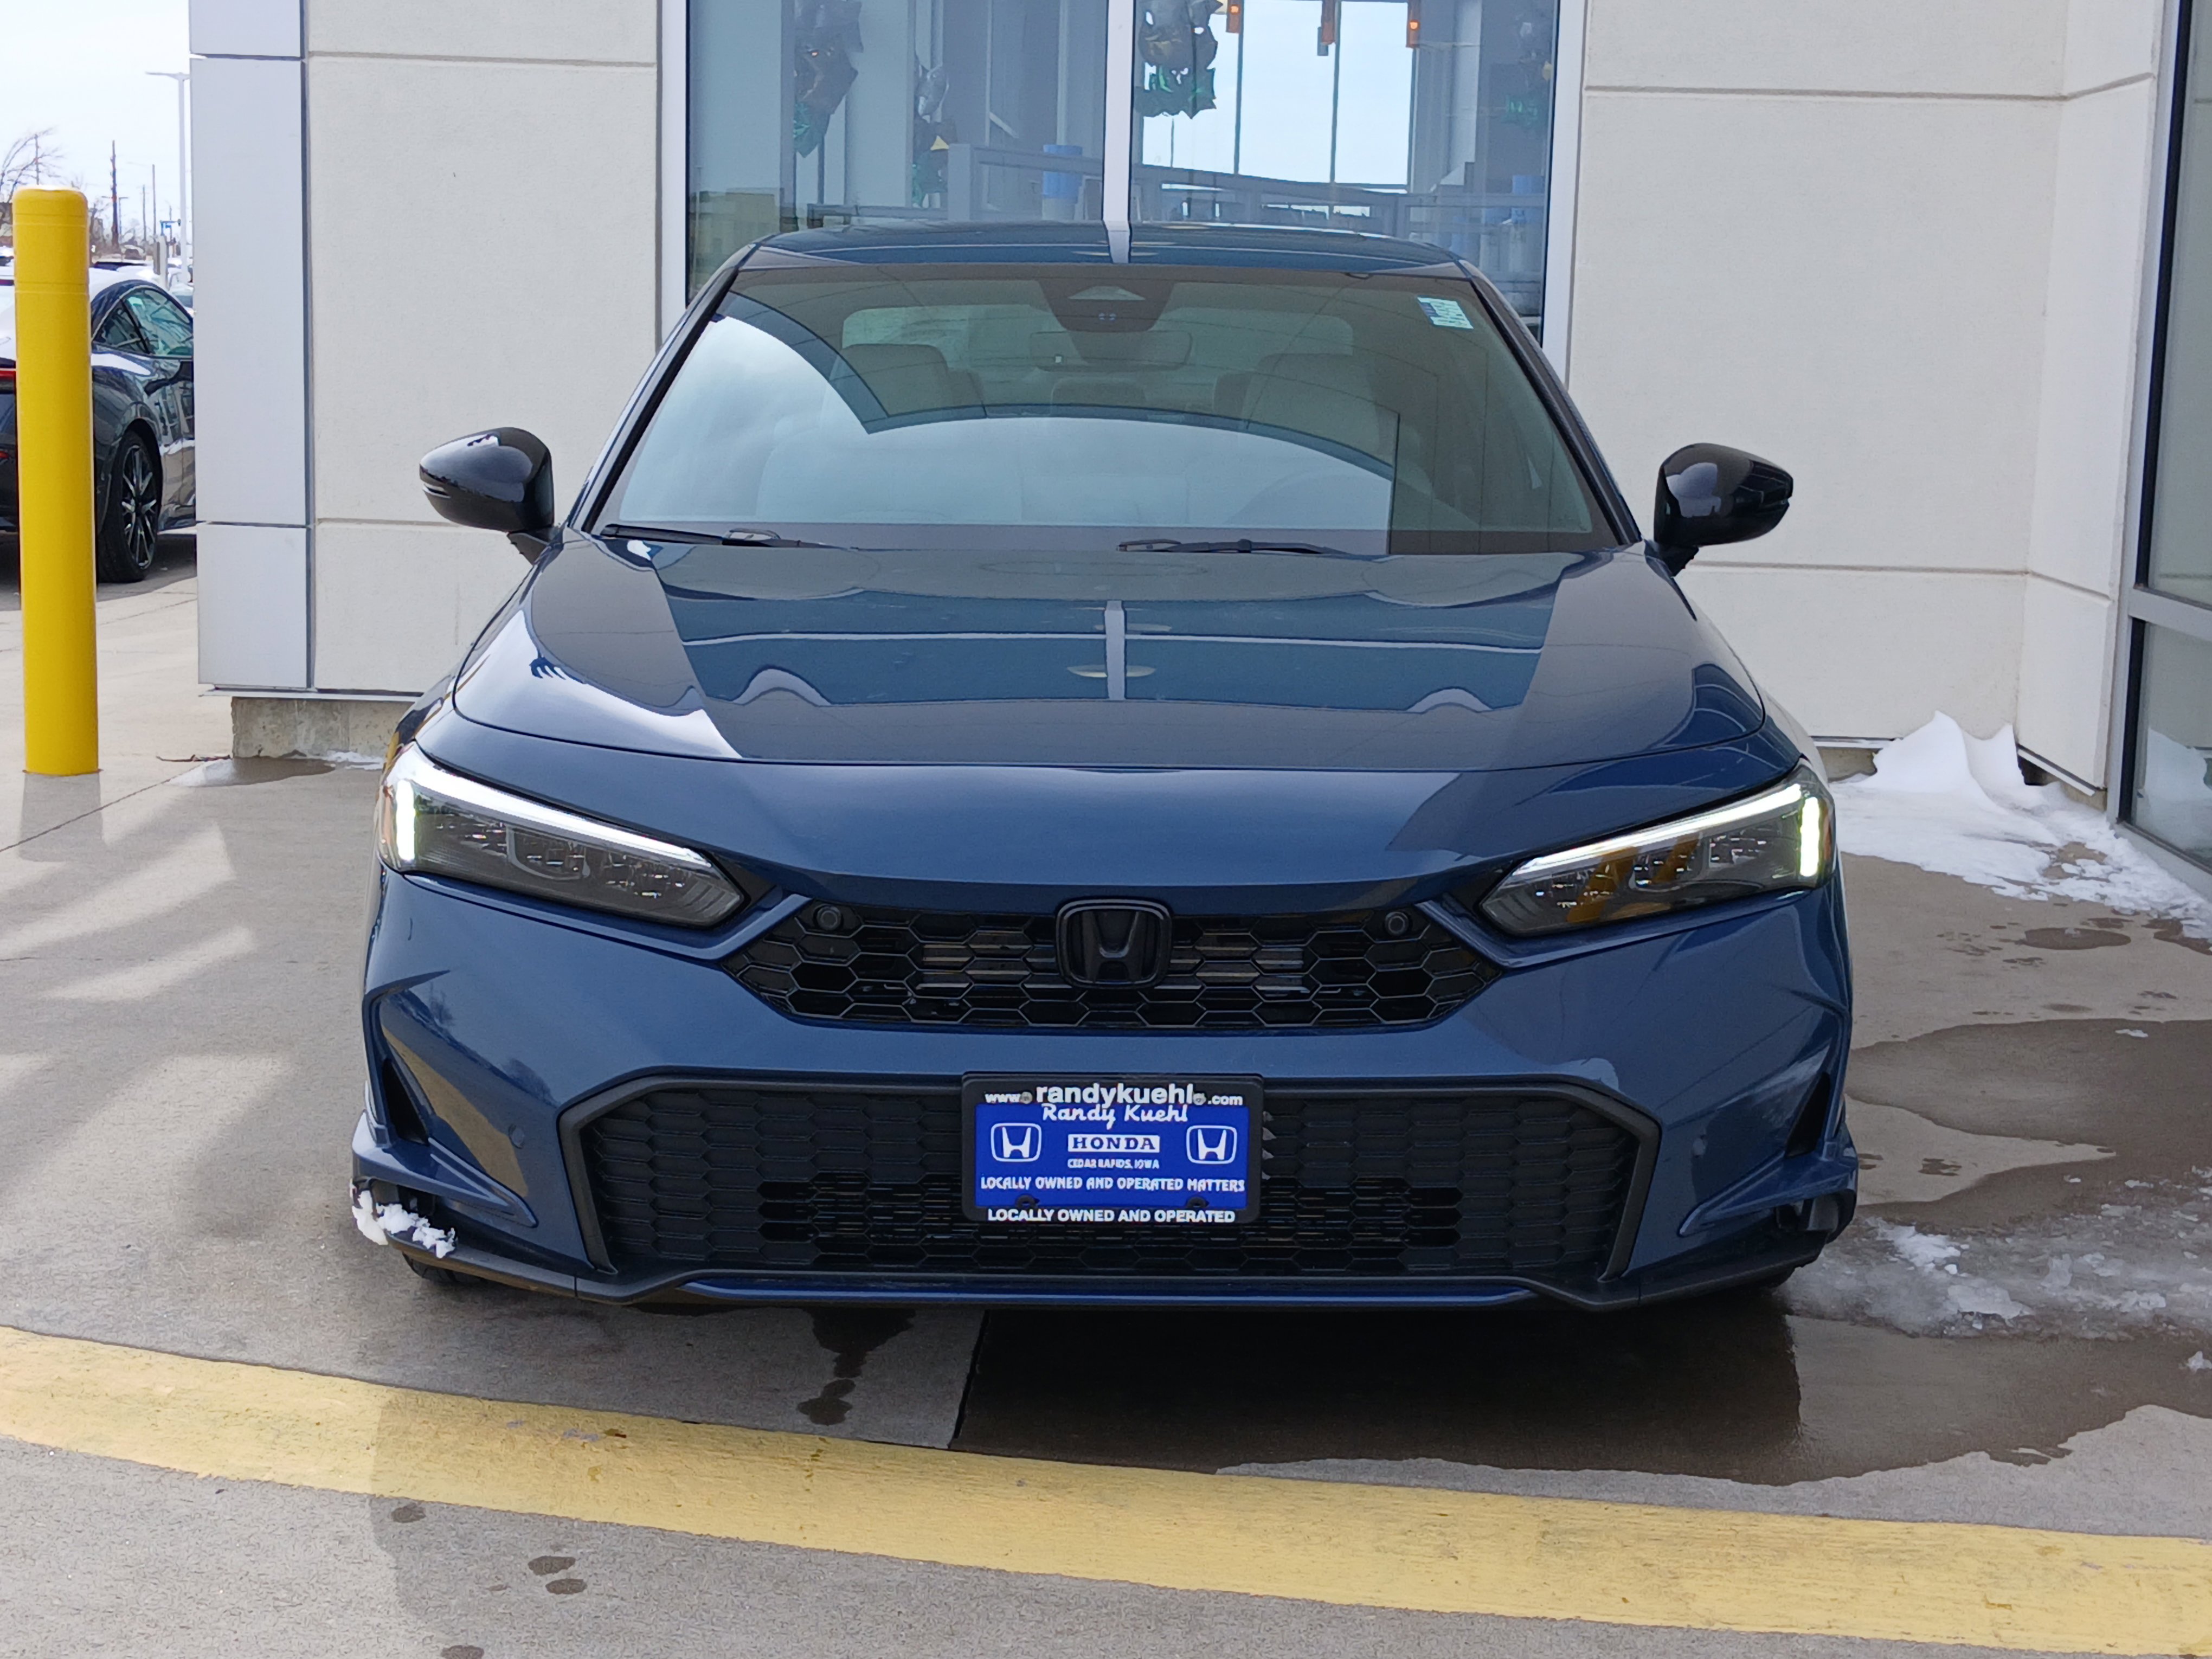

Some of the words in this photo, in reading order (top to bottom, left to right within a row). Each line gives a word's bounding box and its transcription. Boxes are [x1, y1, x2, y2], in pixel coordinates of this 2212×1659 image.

[1036, 1083, 1193, 1108] randykuehl
[1041, 1103, 1116, 1130] Randy
[1124, 1104, 1188, 1122] Kuehl
[1072, 1137, 1156, 1150] HONDA
[981, 1176, 1031, 1190] LOCALLY
[1035, 1176, 1083, 1189] OWNED
[1086, 1177, 1114, 1190] AND
[1117, 1177, 1184, 1191] OPERATED
[1187, 1178, 1245, 1192] MATTERS
[988, 1208, 1054, 1221] LOCALLY
[1057, 1209, 1115, 1221] OWNED
[1118, 1210, 1151, 1222] AND
[1154, 1210, 1236, 1223] OPERATED
